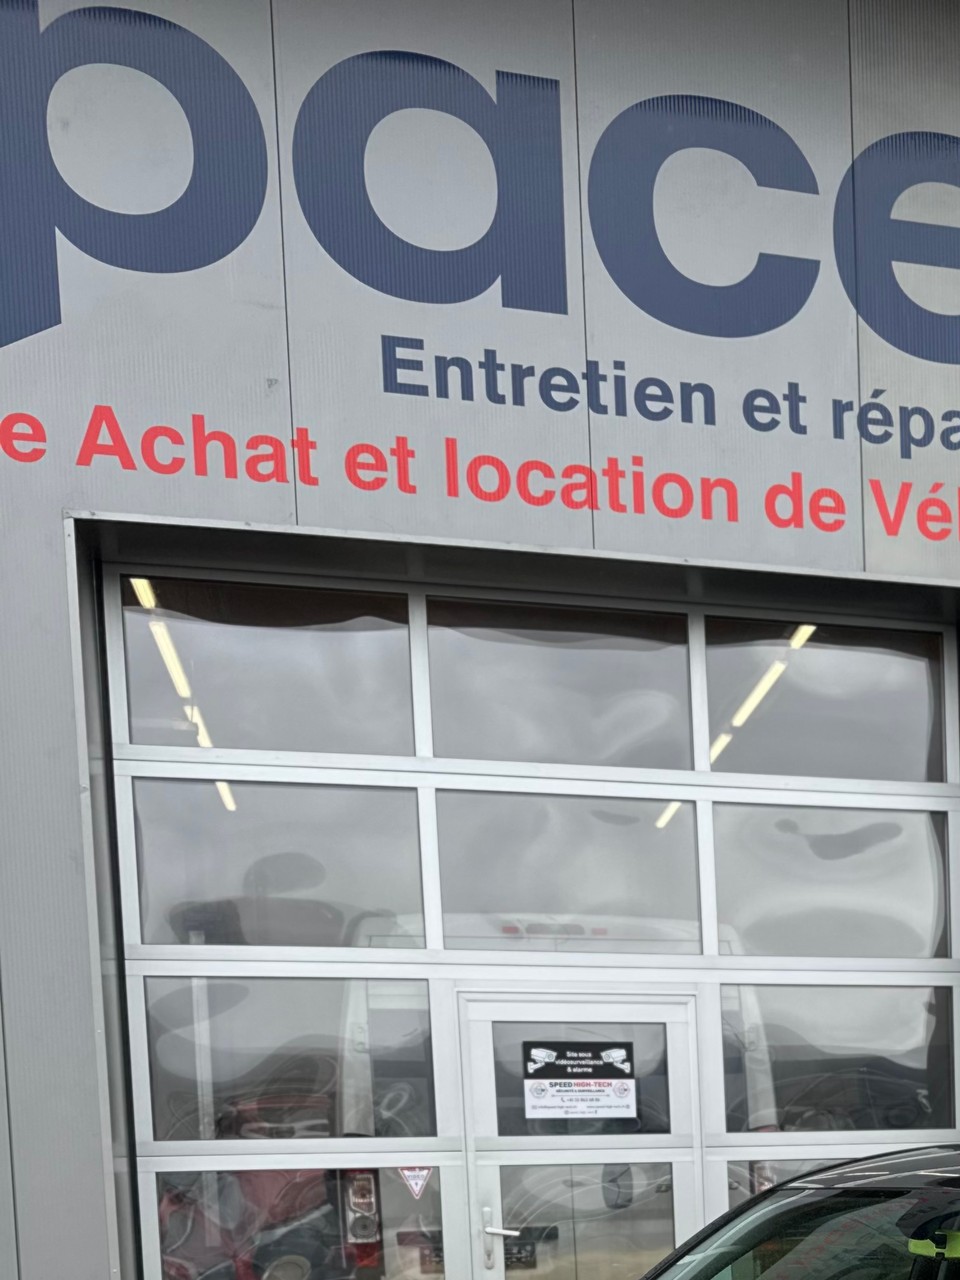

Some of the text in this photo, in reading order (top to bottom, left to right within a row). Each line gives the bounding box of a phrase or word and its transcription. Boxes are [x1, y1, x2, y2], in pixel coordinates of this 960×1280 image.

[381, 334, 717, 427] Entretien
[742, 383, 808, 436] et
[75, 404, 320, 486] Achat
[344, 435, 417, 495] et
[444, 436, 739, 523] location
[763, 471, 847, 533] de
